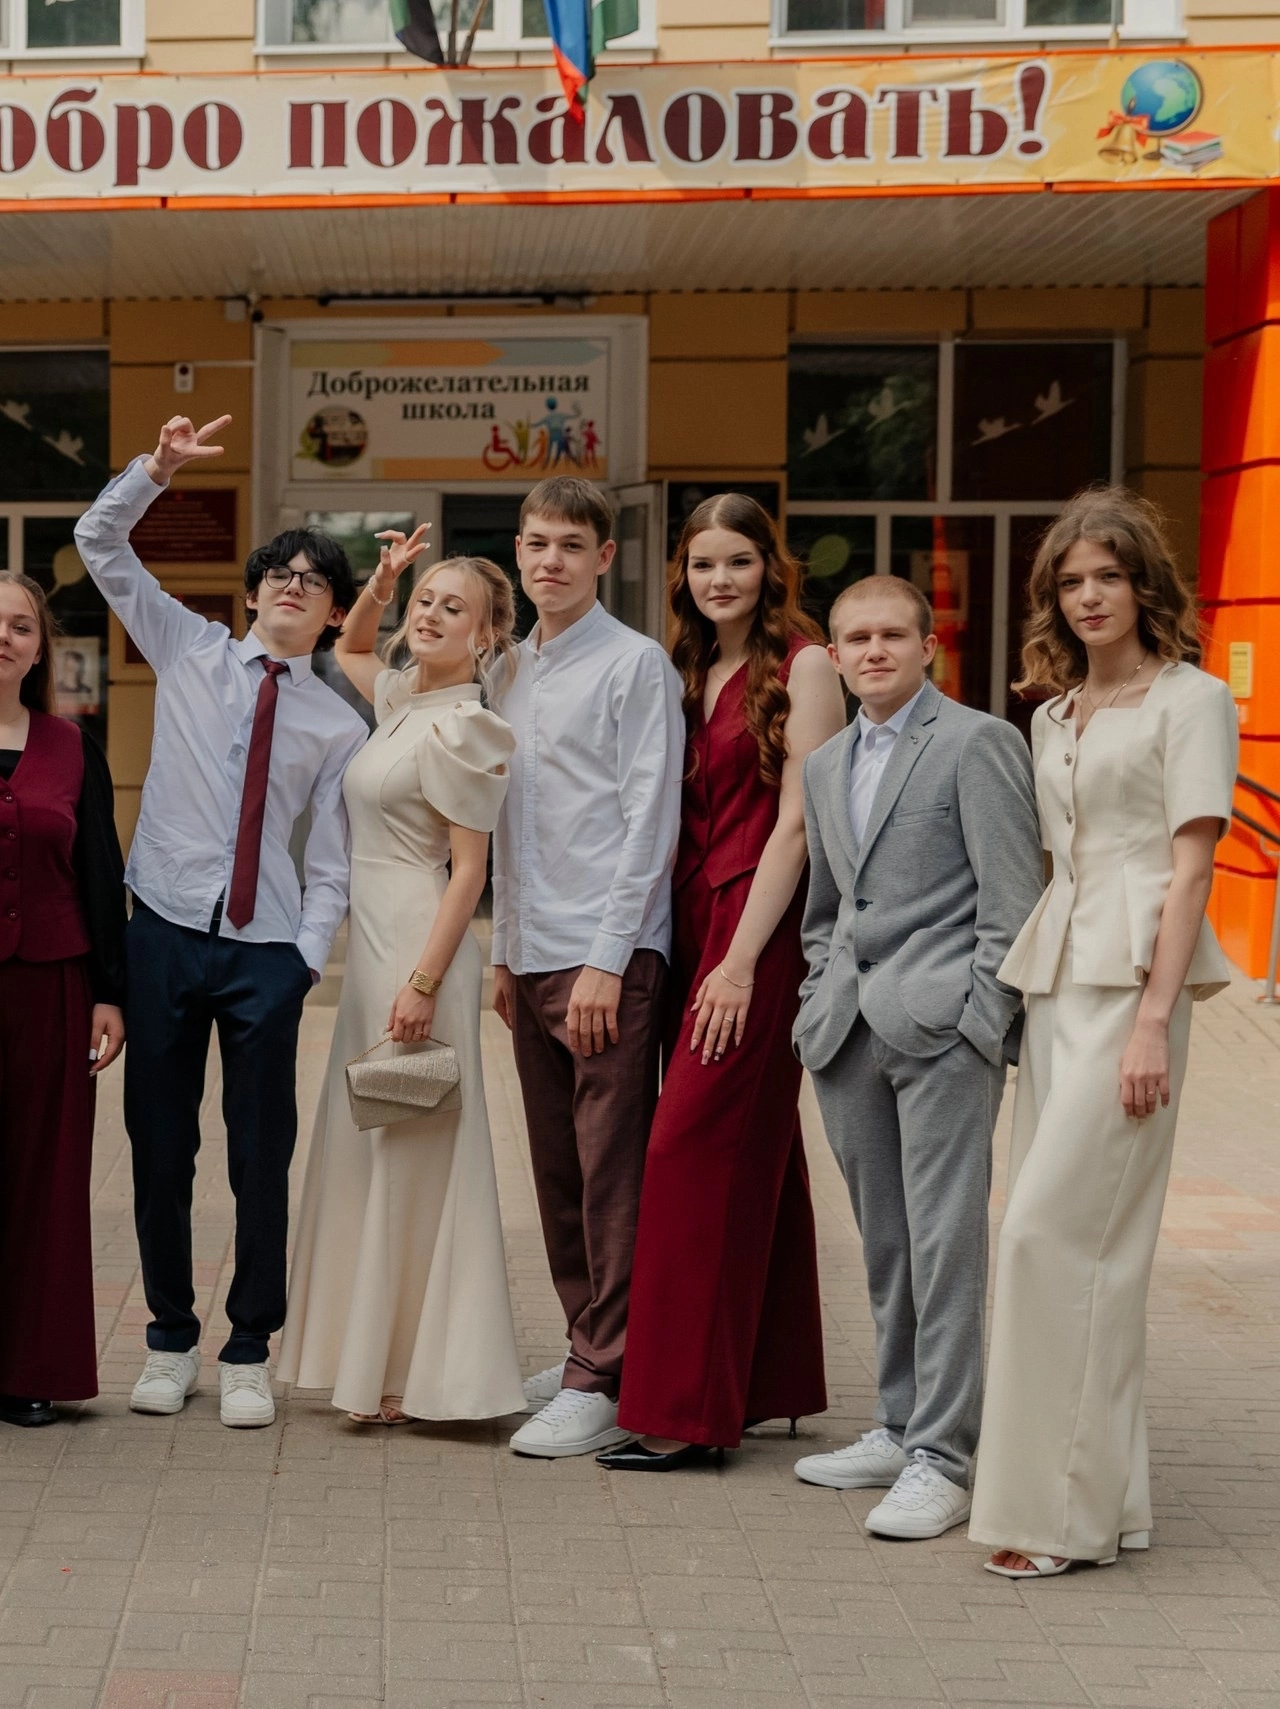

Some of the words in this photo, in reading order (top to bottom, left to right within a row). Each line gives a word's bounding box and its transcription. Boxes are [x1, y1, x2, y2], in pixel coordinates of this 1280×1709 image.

[288, 66, 1047, 166] пожаловать!
[308, 371, 589, 399] Доброжелательная
[402, 402, 496, 420] школа
